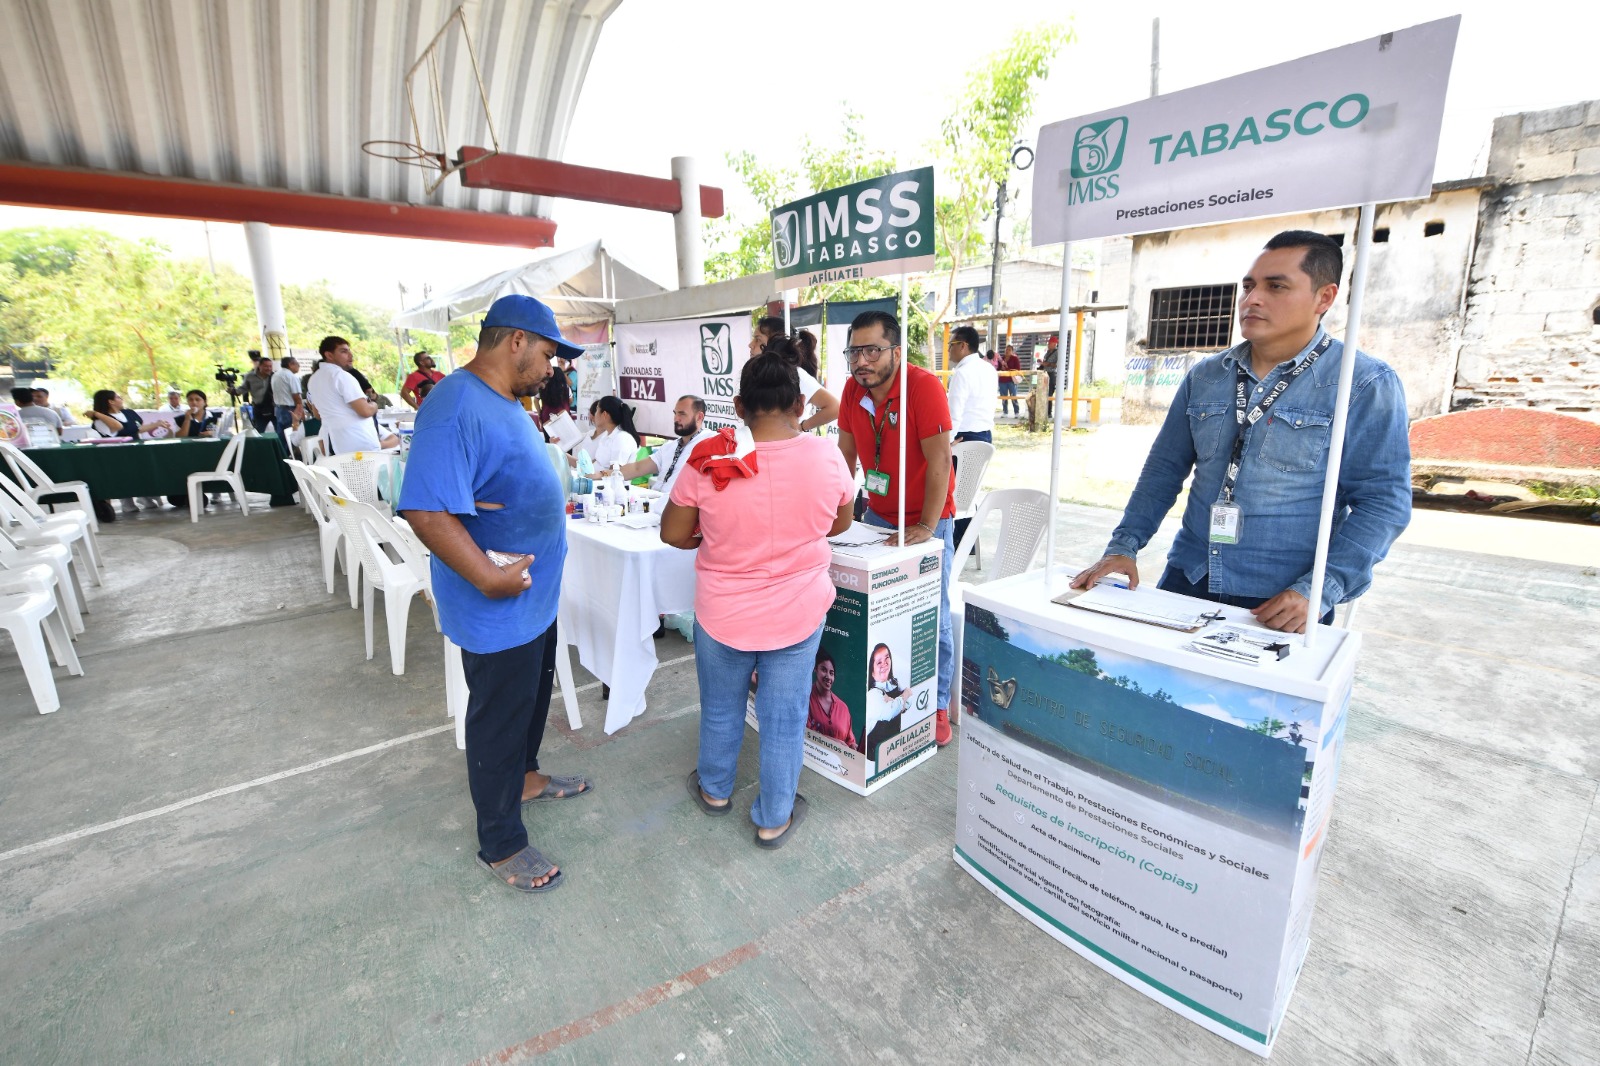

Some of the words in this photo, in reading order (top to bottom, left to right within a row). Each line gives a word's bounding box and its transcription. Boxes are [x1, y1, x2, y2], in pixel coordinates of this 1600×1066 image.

[1149, 93, 1370, 165] TABASCO
[1067, 173, 1120, 206] IMSS
[1116, 198, 1205, 221] Prestaciones
[1208, 187, 1274, 207] Sociales
[805, 181, 921, 245] IMSS
[807, 230, 922, 265] TABASCO
[621, 367, 653, 376] JORNADAS
[654, 367, 662, 376] DE
[1293, 361, 1310, 376] IMSS
[630, 379, 657, 400] PAZ
[703, 377, 734, 397] IMSS
[1237, 382, 1245, 397] IMSS
[1263, 391, 1279, 407] IMSS
[871, 567, 900, 580] ESTIMADO
[830, 604, 861, 616] aciones
[812, 735, 842, 753] minutos
[843, 750, 855, 760] en:
[1020, 687, 1066, 718] CENTRO
[1074, 710, 1090, 729] DE
[1100, 720, 1174, 761] SEGURIDAD
[1184, 751, 1233, 783] SOCIAL
[991, 749, 1001, 759] de
[1001, 754, 1022, 771] Salud
[1022, 767, 1033, 777] en
[1033, 771, 1042, 781] el
[1043, 775, 1077, 799] Trabajo,
[1077, 793, 1138, 827] Prestaciones
[1140, 821, 1207, 856] Económicas
[1208, 851, 1217, 861] y
[1219, 855, 1270, 880] Sociales
[1007, 769, 1064, 804] Departamento
[1065, 801, 1077, 810] de
[1078, 805, 1139, 840] Prestaciones
[1140, 835, 1184, 861] Sociales
[995, 783, 1048, 819] Requisitos
[1050, 815, 1065, 828] de
[1067, 822, 1135, 864] inscripción
[1139, 858, 1199, 894] (Copias)
[1030, 823, 1047, 836] Acta
[1047, 833, 1057, 842] de
[1058, 838, 1101, 866] nacimiento
[1017, 861, 1037, 878] oficial
[1037, 872, 1064, 895] vigente
[1065, 892, 1079, 903] con
[1080, 899, 1121, 928] fotografía:
[1018, 840, 1027, 849] de
[1062, 863, 1088, 887] (recibo
[1089, 883, 1099, 892] de
[1101, 889, 1138, 914] teléfono,
[1139, 909, 1163, 927] agua,
[1165, 922, 1180, 934] luz
[1189, 935, 1228, 959] predial)
[1008, 863, 1023, 876] para
[1043, 886, 1067, 905] cartilla
[1067, 901, 1080, 912] del
[1080, 909, 1111, 930] servicio
[1112, 928, 1139, 946] militar
[1141, 942, 1180, 968] nacional
[1181, 964, 1188, 972] o
[1189, 969, 1243, 1001] pasaporte)
